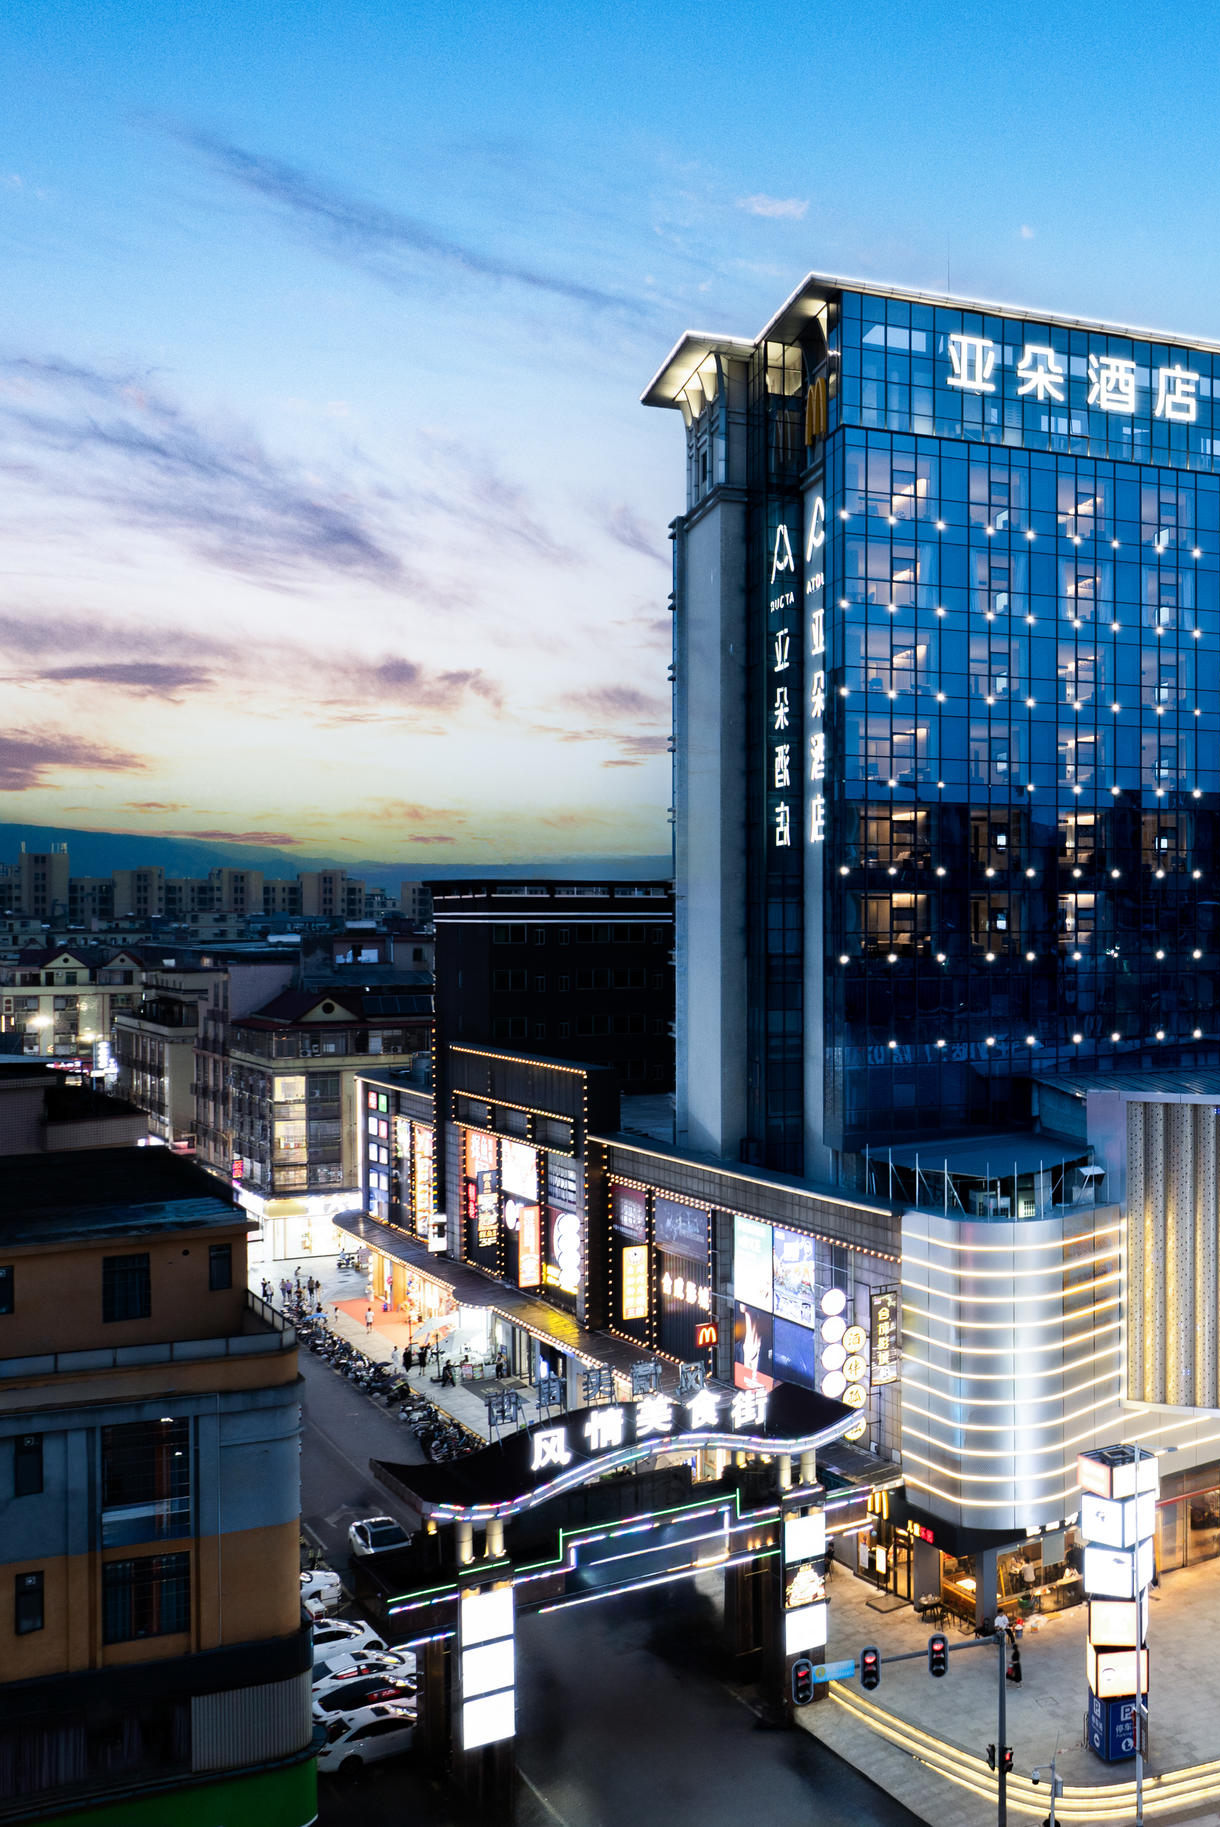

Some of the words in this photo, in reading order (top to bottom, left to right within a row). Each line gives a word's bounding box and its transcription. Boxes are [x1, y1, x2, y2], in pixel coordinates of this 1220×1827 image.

[947, 333, 1199, 422] 亚朵酒店
[531, 1388, 769, 1471] 风情美食街
